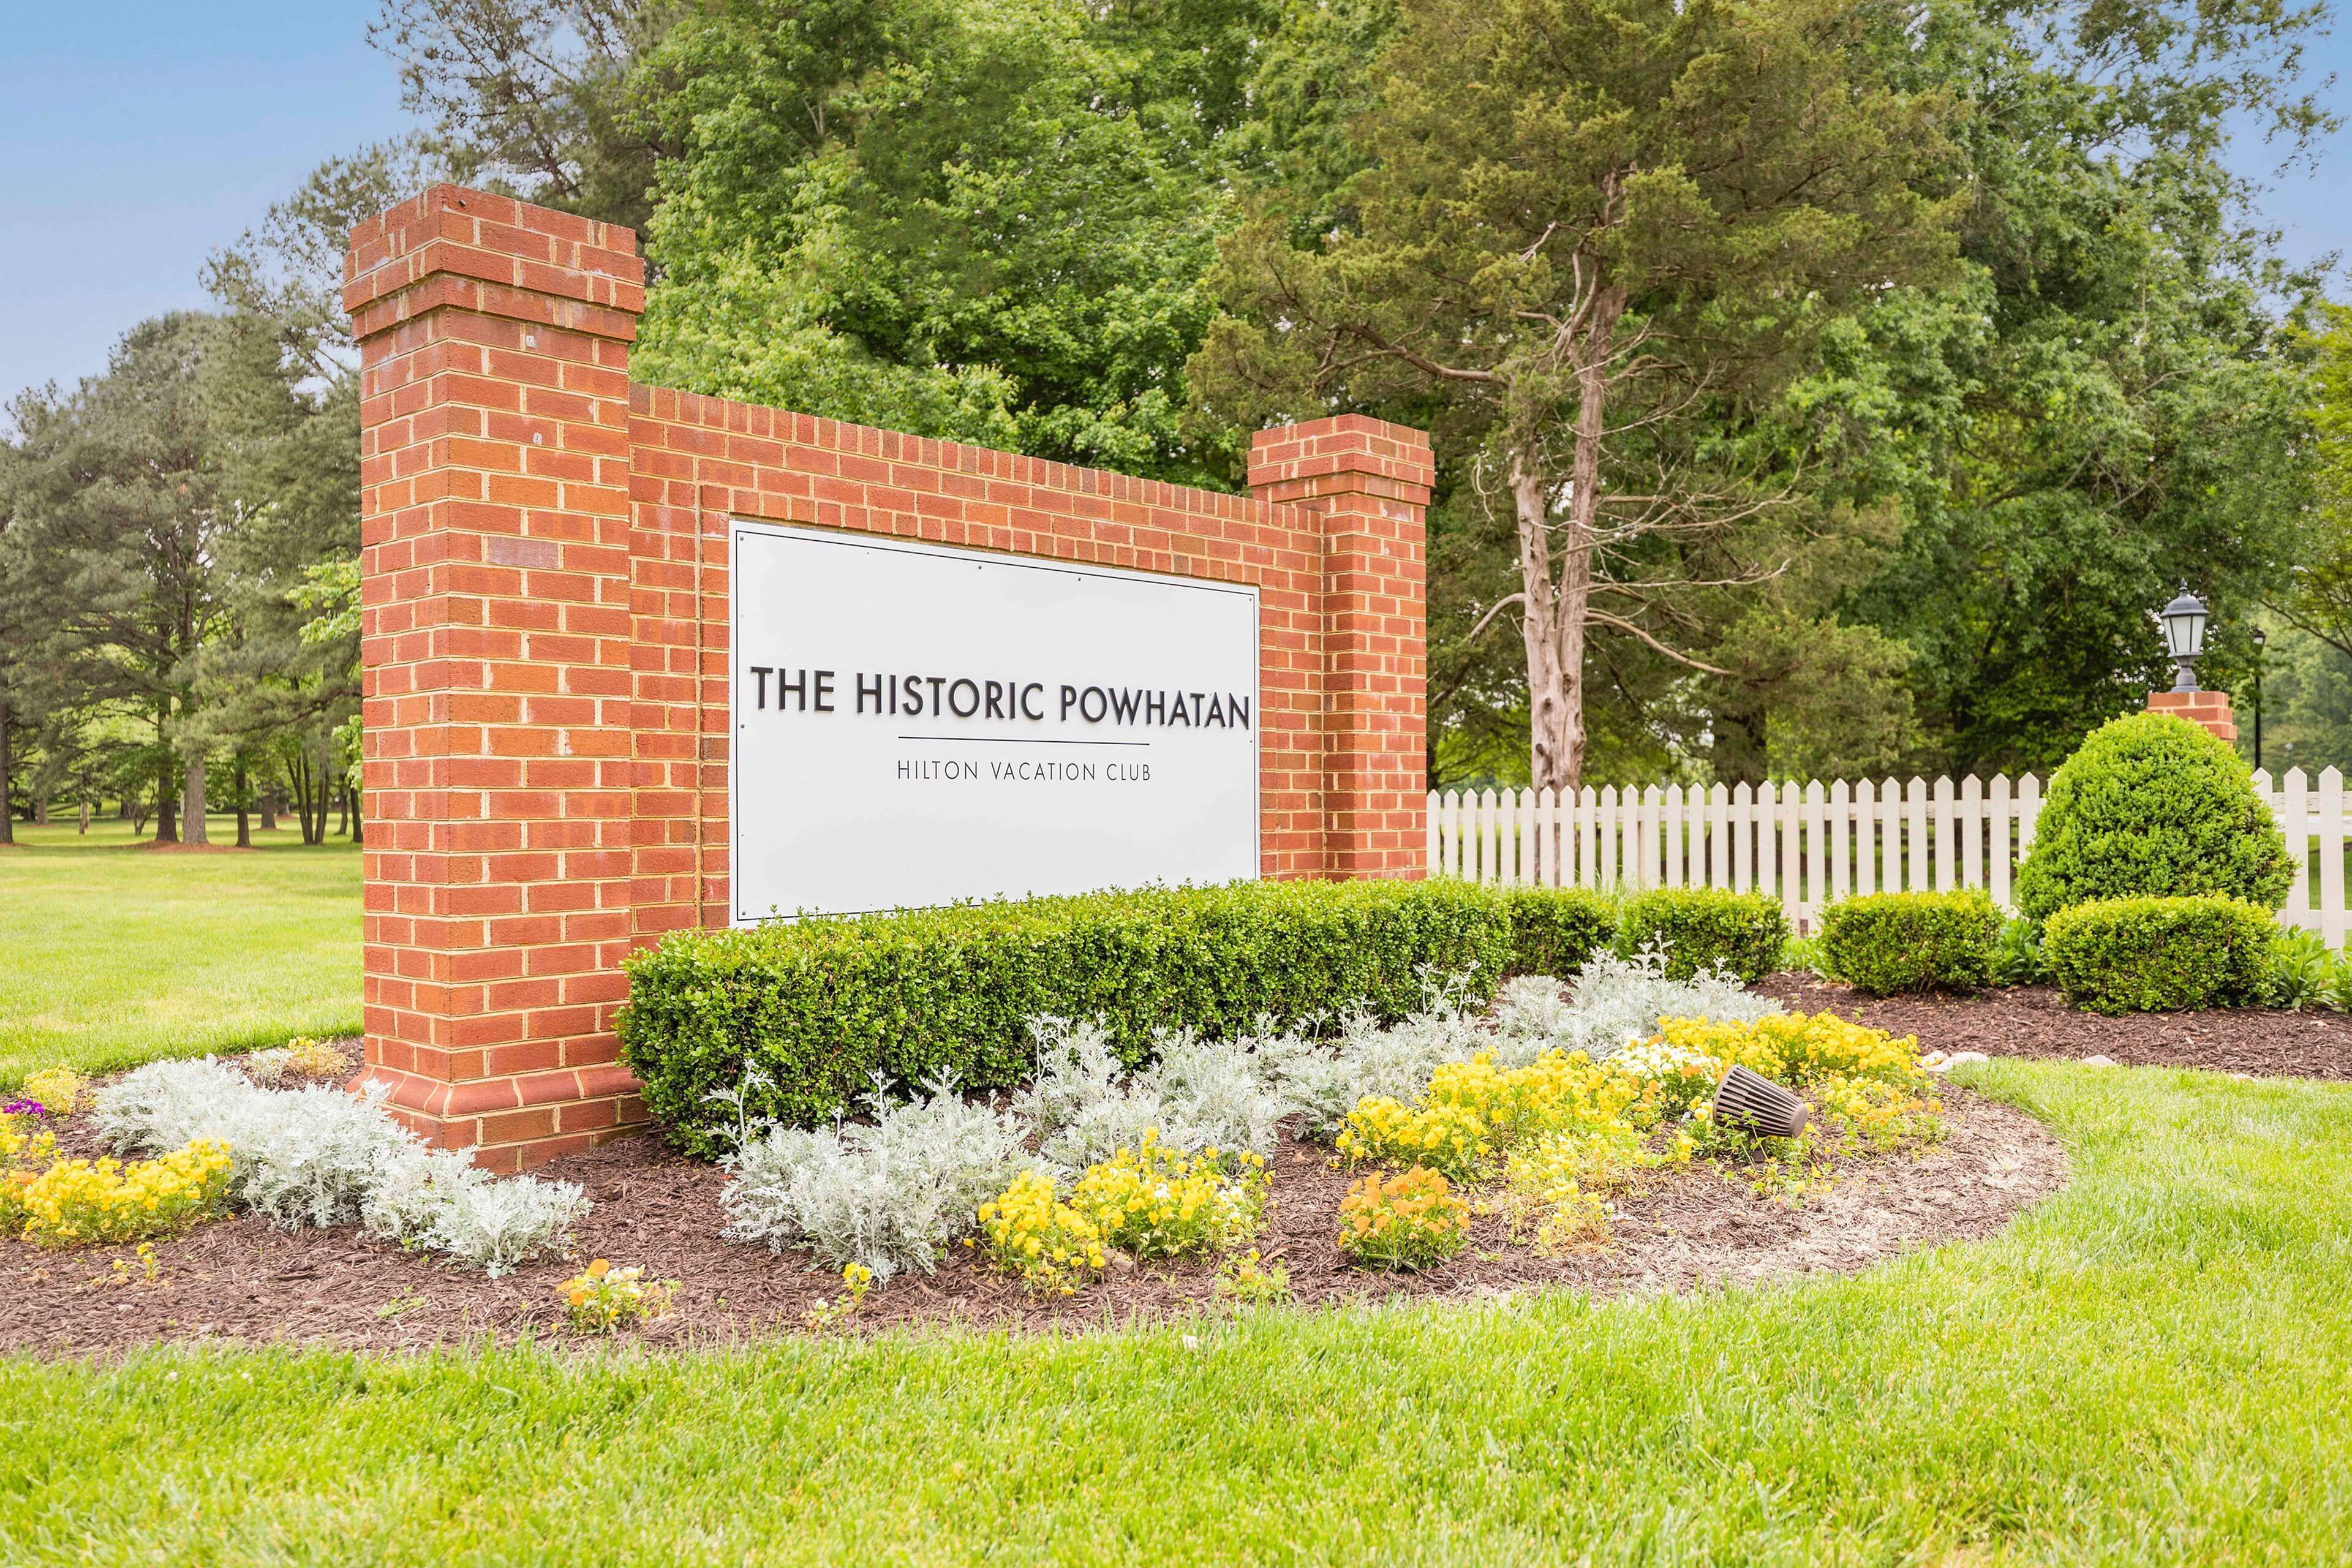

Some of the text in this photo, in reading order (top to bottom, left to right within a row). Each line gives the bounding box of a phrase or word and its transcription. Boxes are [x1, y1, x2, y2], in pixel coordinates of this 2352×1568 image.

[750, 666, 1250, 730] THE HISTORIC POWHATAN
[898, 760, 1151, 781] HILTON VACATION CLUB
